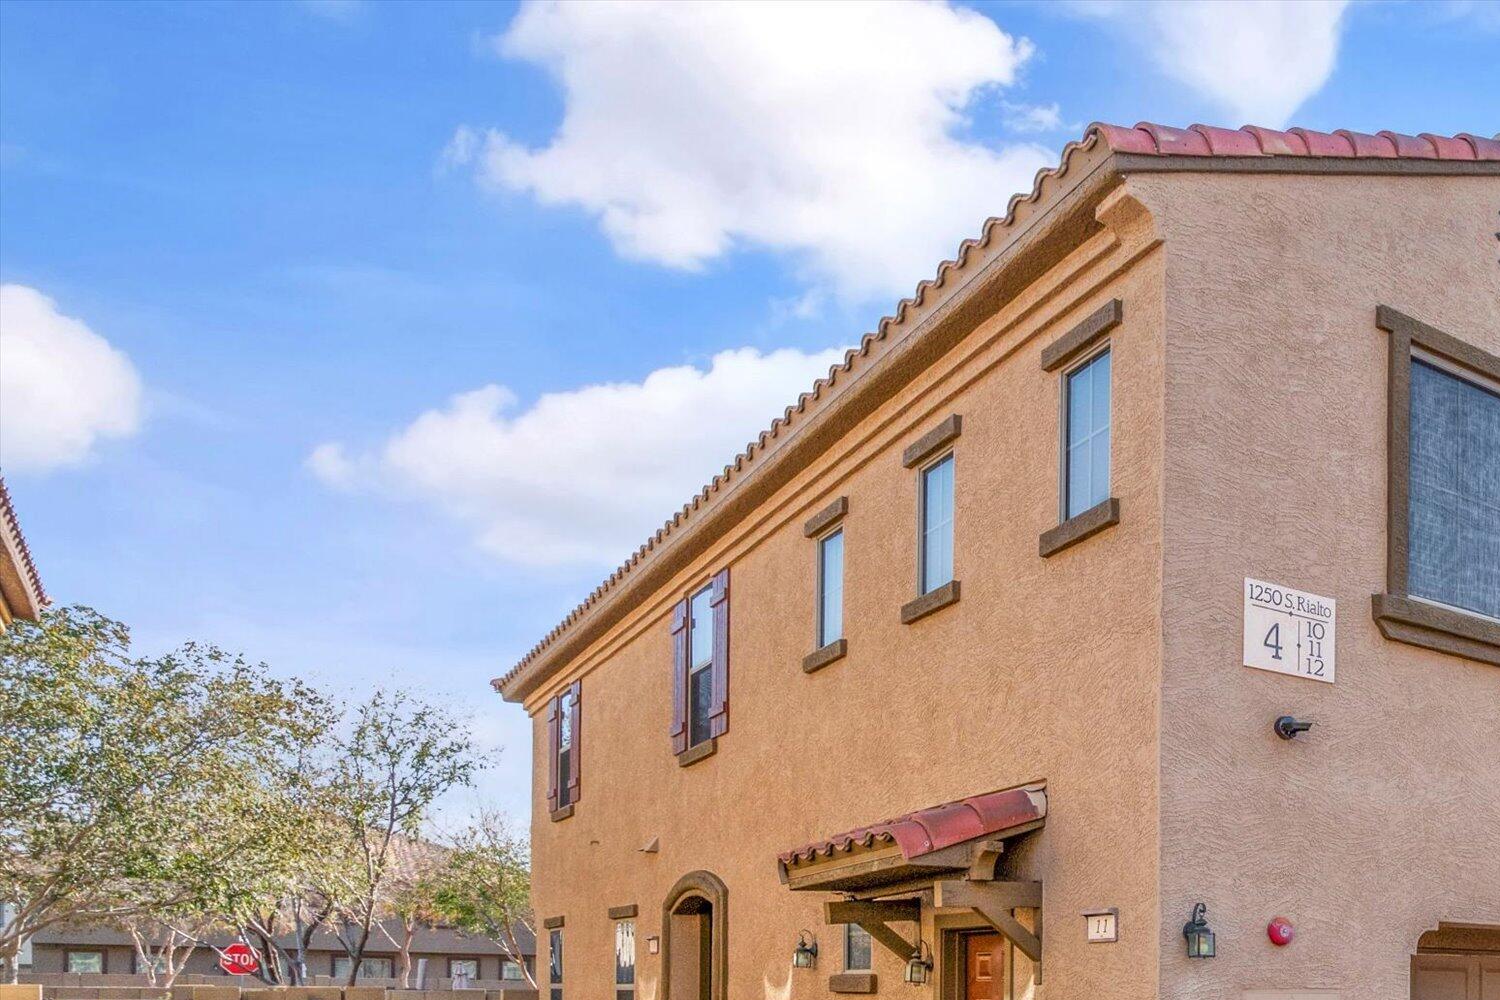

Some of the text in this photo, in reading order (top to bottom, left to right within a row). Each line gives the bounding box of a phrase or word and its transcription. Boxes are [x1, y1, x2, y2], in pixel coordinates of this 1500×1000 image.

[1249, 583, 1332, 618] 1250 S. Rialto
[1306, 621, 1325, 640] 10
[1263, 622, 1283, 660] 4
[1309, 640, 1322, 659] 11
[1306, 658, 1324, 677] 12
[1096, 919, 1107, 933] 11
